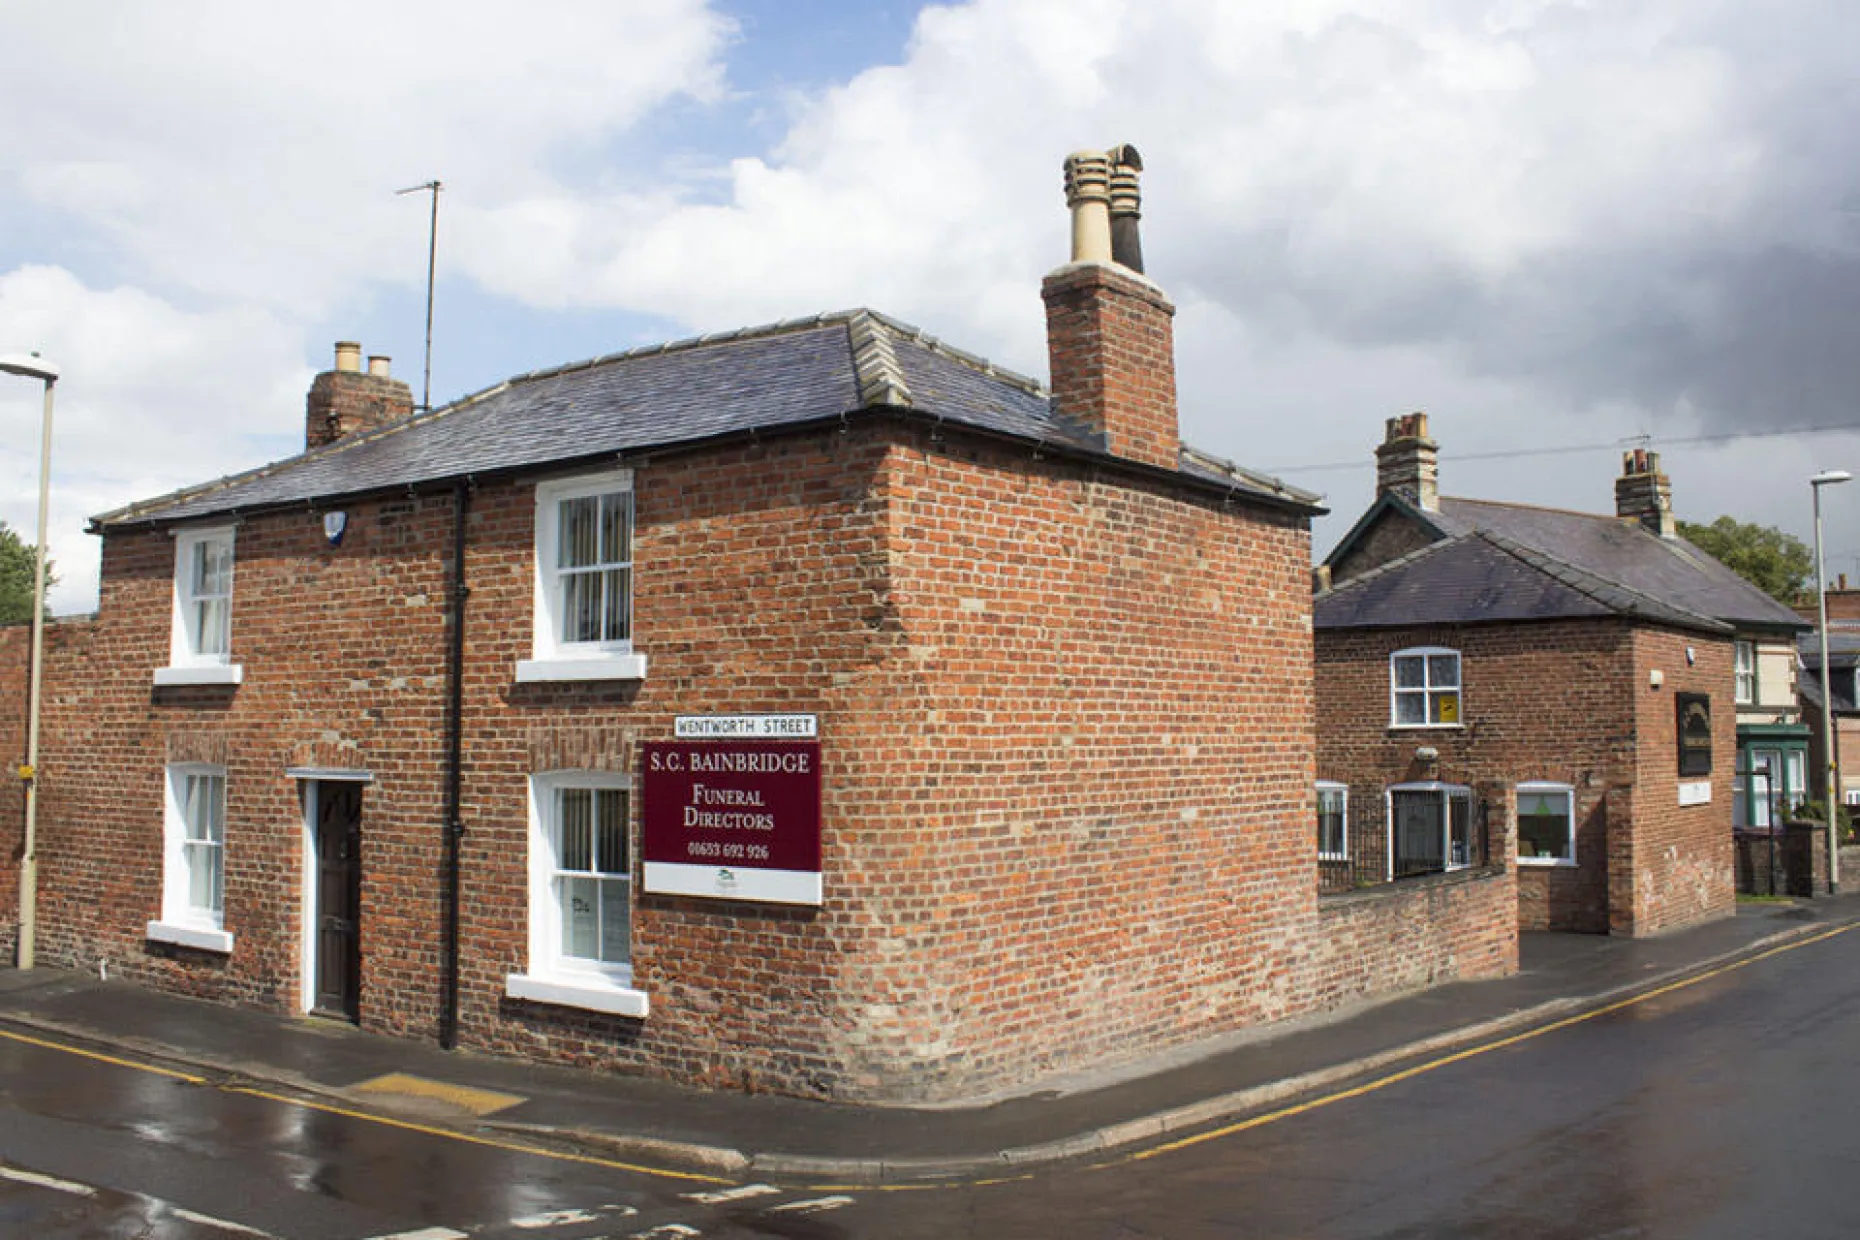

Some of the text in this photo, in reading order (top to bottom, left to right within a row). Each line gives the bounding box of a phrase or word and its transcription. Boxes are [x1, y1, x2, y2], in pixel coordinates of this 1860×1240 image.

[678, 719, 811, 733] WENTWORTH STREET
[650, 752, 810, 773] S.C. BAINBRIDGE
[723, 843, 744, 858] 692
[746, 844, 769, 860] 926
